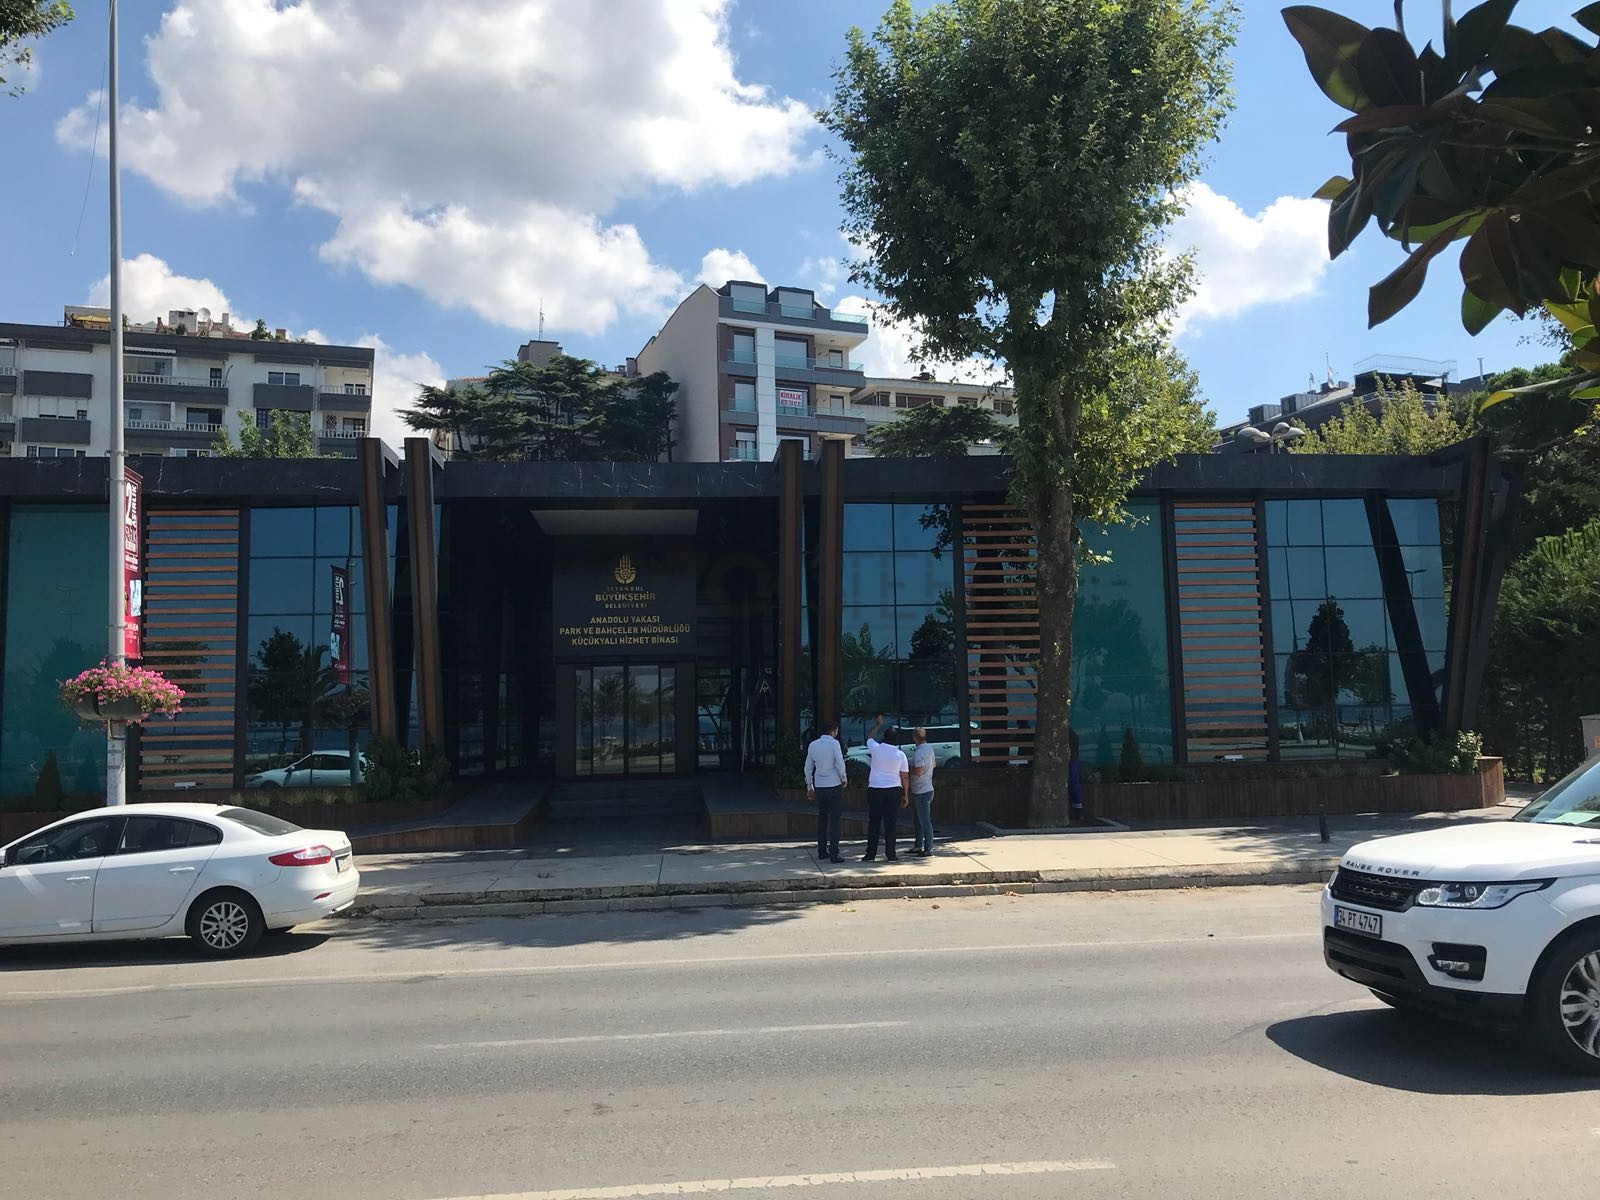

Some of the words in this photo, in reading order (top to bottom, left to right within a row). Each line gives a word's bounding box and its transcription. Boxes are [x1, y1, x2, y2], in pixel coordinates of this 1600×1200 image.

[595, 591, 656, 602] BÜYÜKŞEHİR
[590, 616, 629, 624] ANADOLU
[631, 615, 660, 623] YAKASI
[559, 627, 582, 635] PARK
[583, 627, 594, 635] VE
[595, 626, 638, 636] BAHÇELER
[640, 623, 690, 634] MÜDÜRLÜĞÜ
[571, 637, 618, 647] KÜÇÜKYALI
[619, 635, 650, 644] HİZMET
[651, 635, 679, 644] BİNASI
[1345, 860, 1373, 871] RANGE
[1377, 866, 1420, 877] ROVER
[1338, 909, 1346, 925] 34
[1347, 911, 1357, 928] PT
[1358, 913, 1378, 933] 4747
